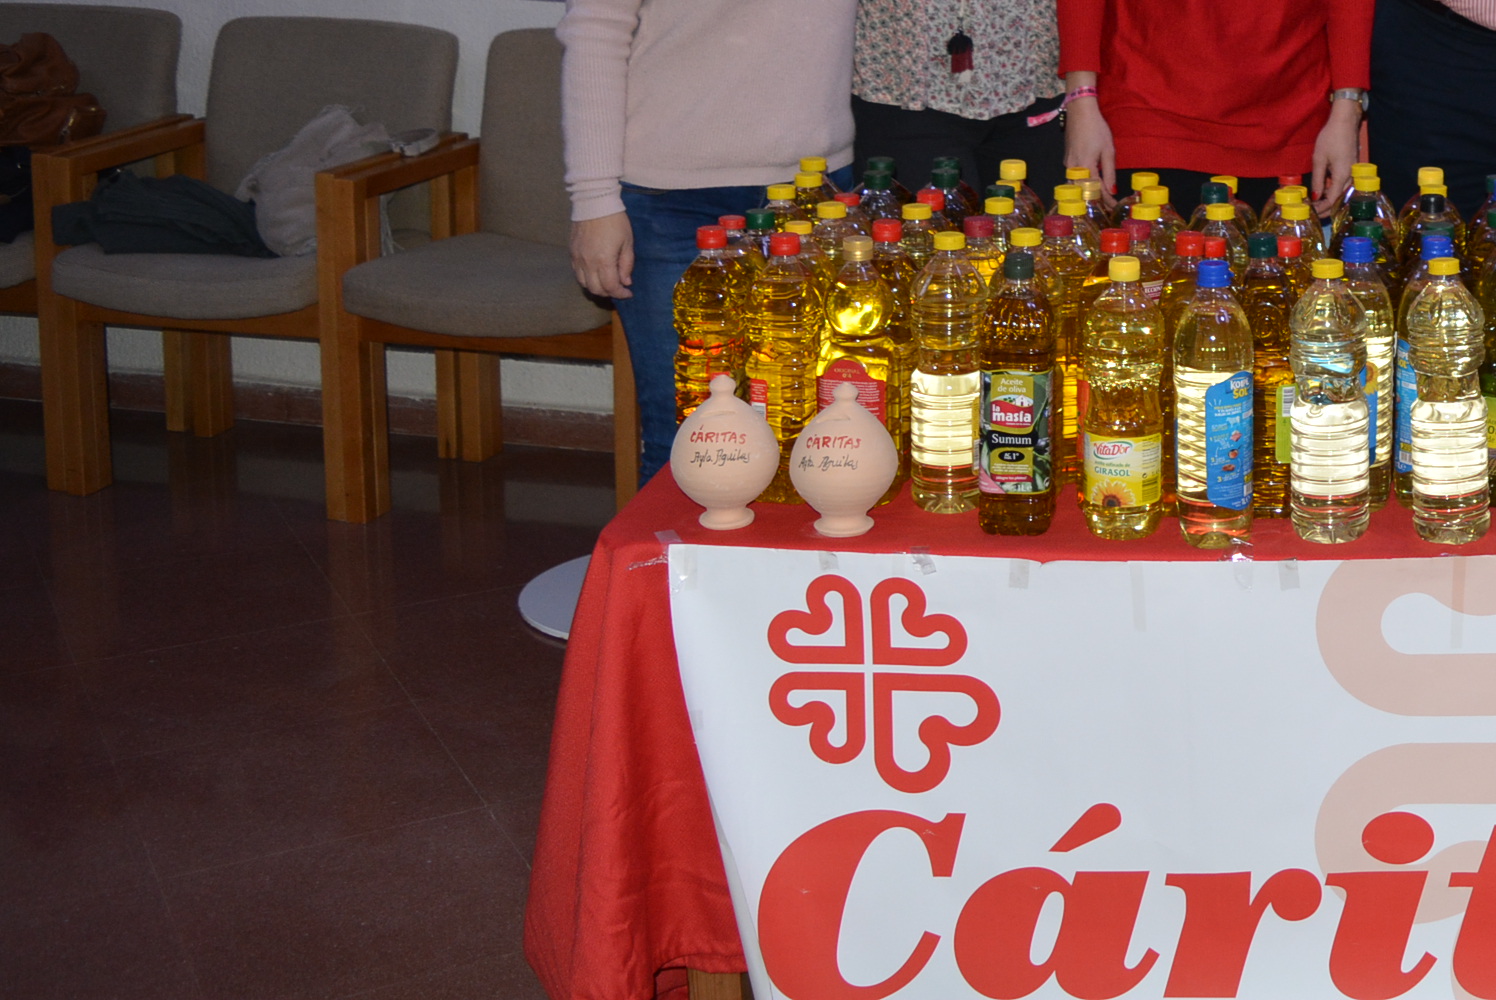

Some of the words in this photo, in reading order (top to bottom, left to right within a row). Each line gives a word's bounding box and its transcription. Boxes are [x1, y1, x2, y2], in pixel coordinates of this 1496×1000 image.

[1000, 378, 1024, 386] Aceite
[997, 385, 1007, 393] de
[1008, 385, 1026, 393] oliva
[1233, 387, 1249, 399] SOL
[992, 403, 1000, 412] la
[992, 410, 1032, 423] masía
[690, 424, 747, 444] CÁRITAS
[991, 433, 1032, 445] Sumum
[1094, 466, 1131, 477] GIRASOL
